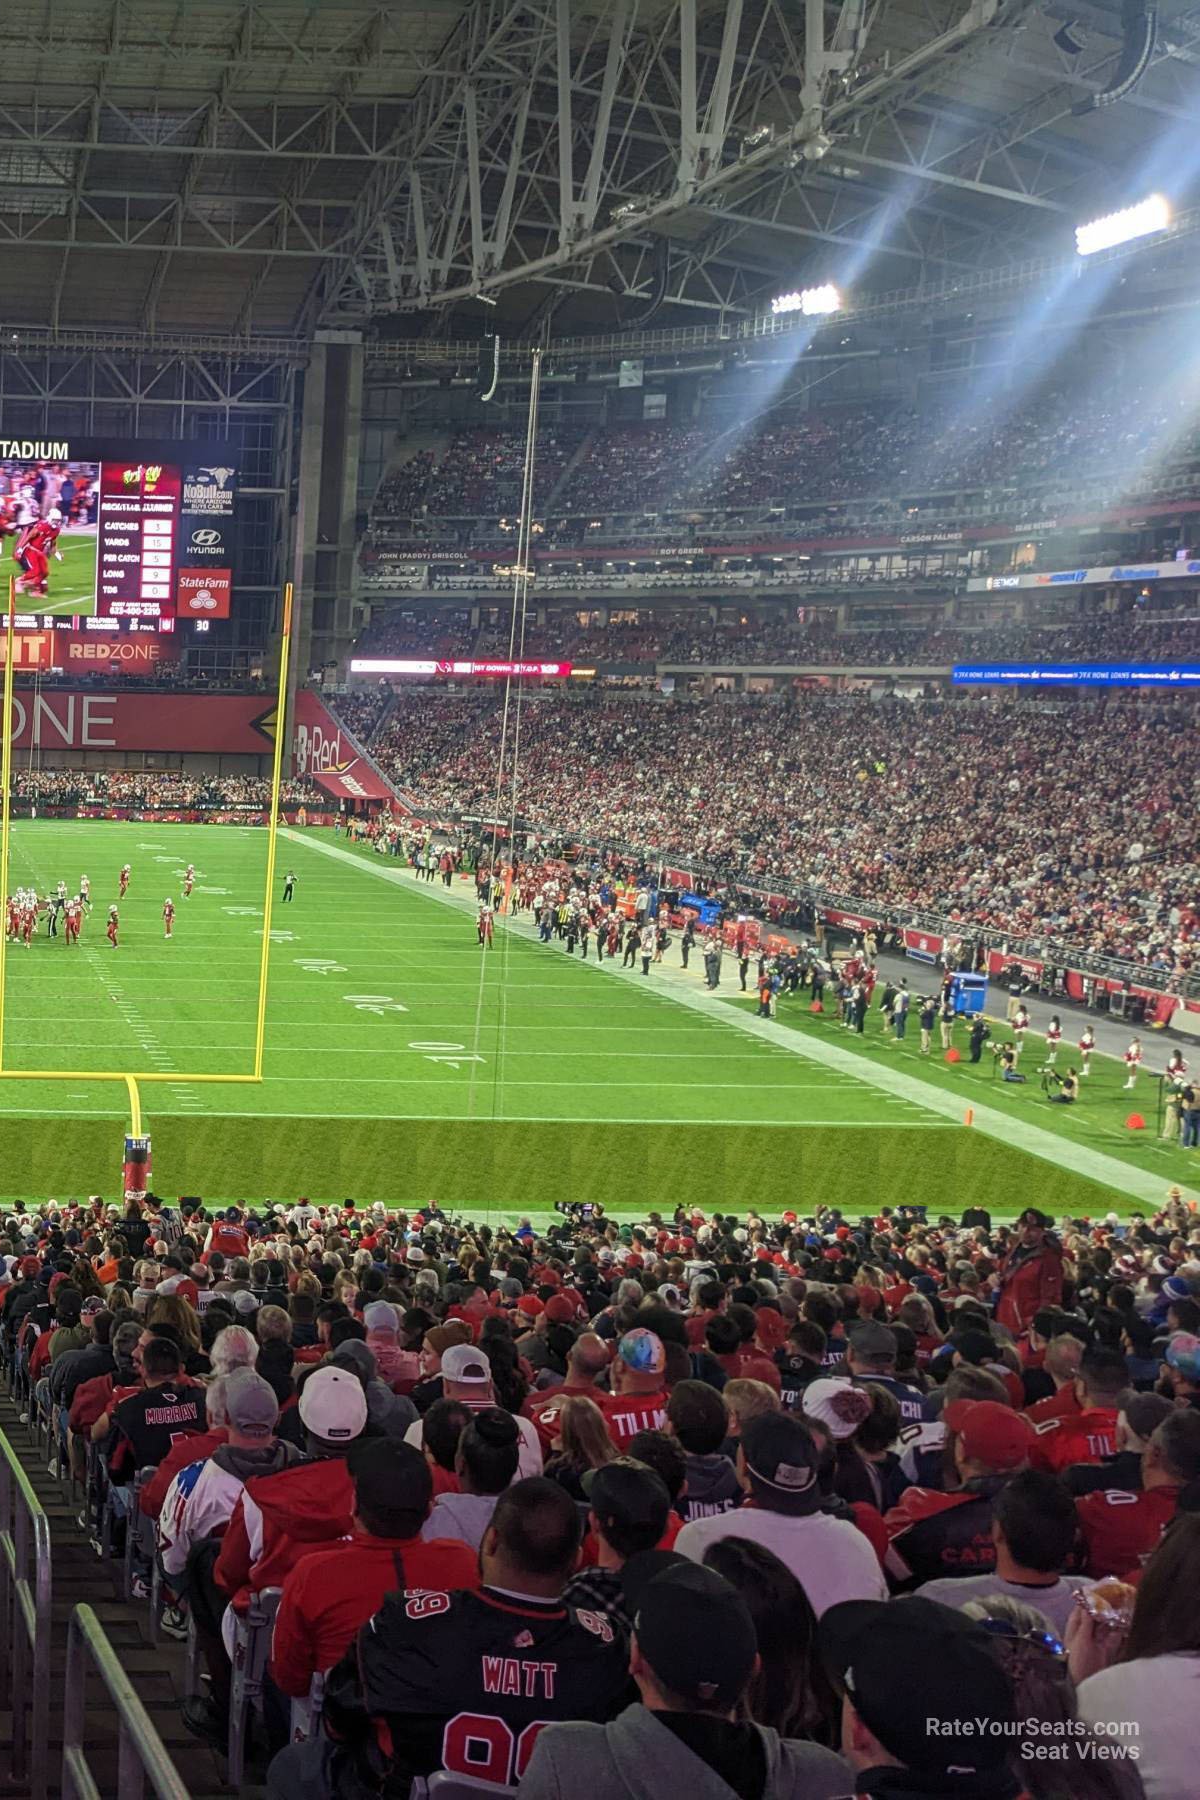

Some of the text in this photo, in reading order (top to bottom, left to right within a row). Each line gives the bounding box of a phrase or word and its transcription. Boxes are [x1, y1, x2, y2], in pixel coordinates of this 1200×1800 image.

[183, 484, 232, 500] NoBull.com
[105, 520, 139, 531] CATCHES
[104, 538, 129, 546] YARDS
[901, 535, 931, 543] CARSON
[103, 554, 117, 562] PER
[103, 570, 124, 578] LONG
[196, 620, 210, 631] 30
[69, 643, 160, 660] REDZONE
[343, 995, 410, 1012] 20
[408, 1042, 487, 1064] 10
[145, 1402, 198, 1425] MURRAY
[684, 1499, 735, 1523] JONES
[482, 1655, 557, 1699] WATT
